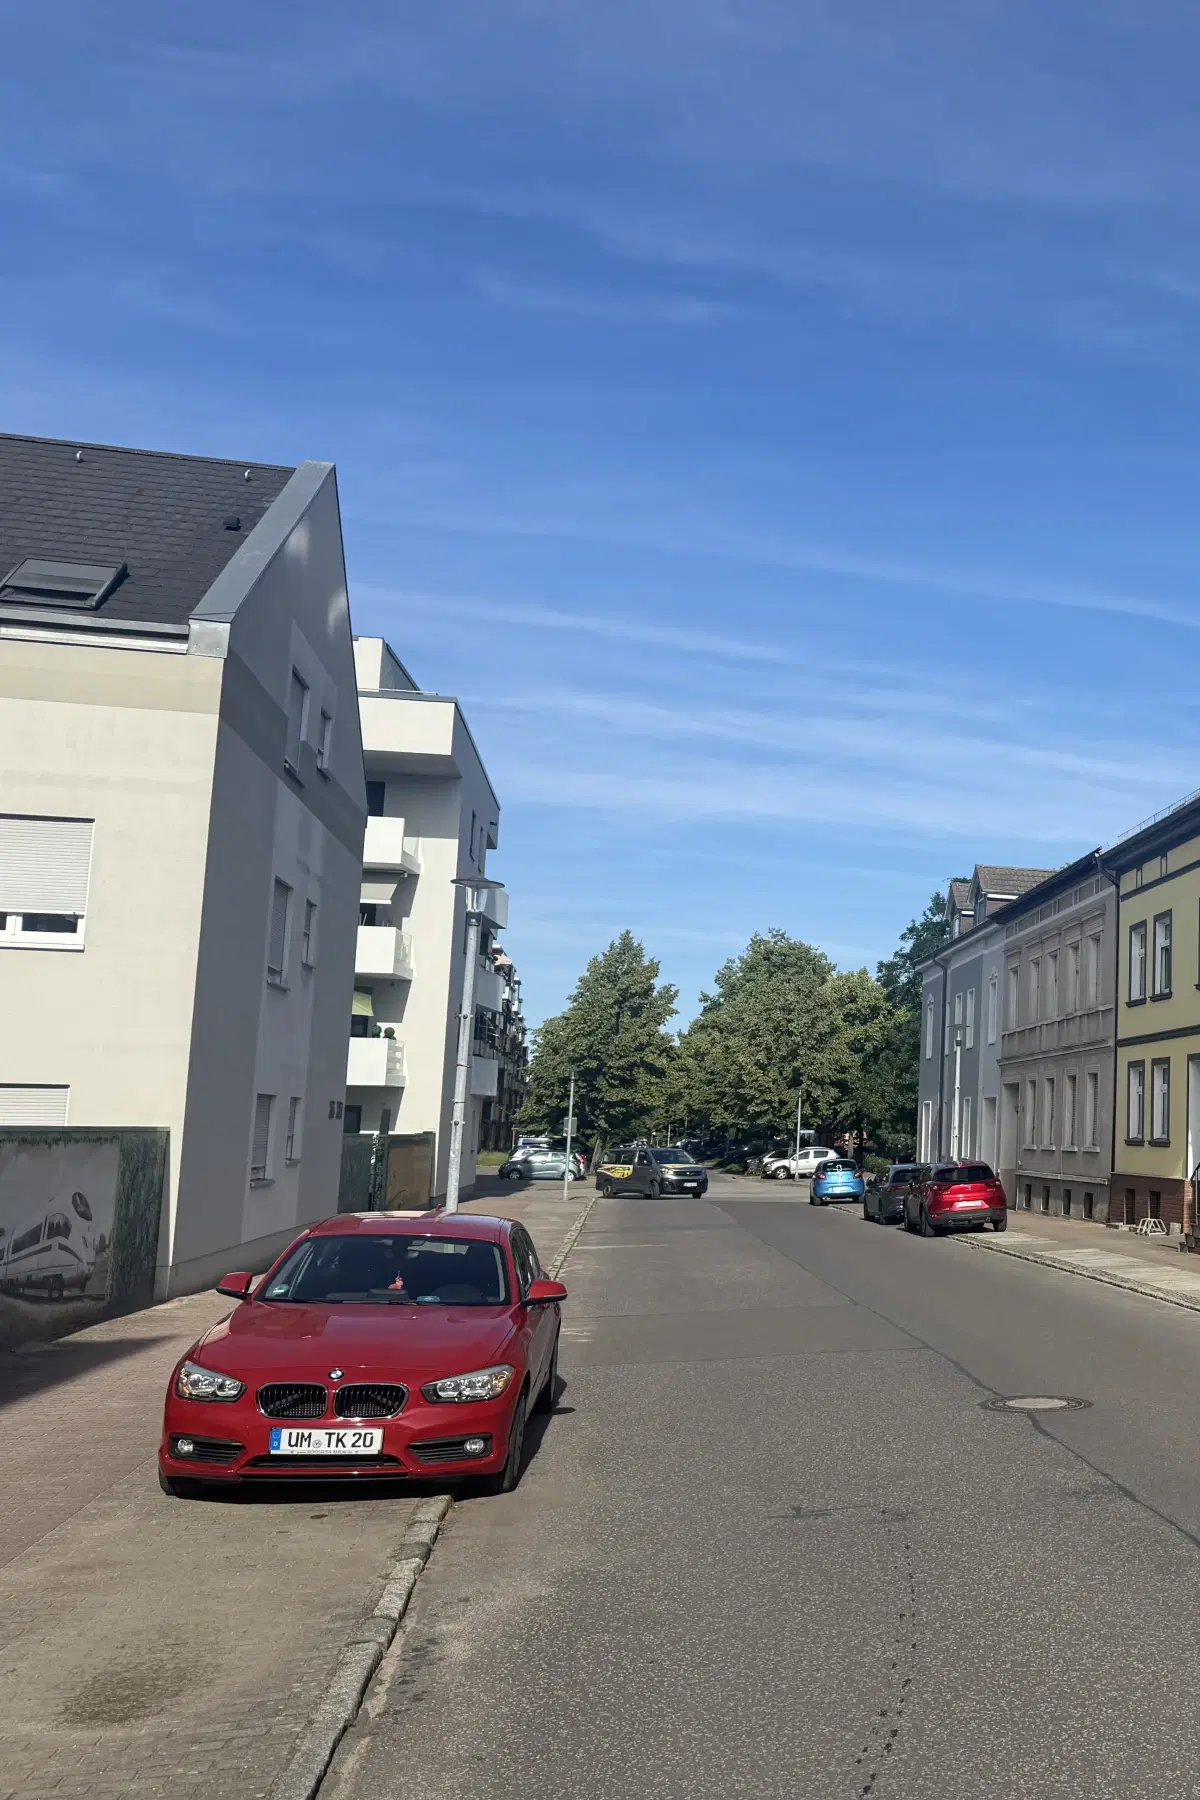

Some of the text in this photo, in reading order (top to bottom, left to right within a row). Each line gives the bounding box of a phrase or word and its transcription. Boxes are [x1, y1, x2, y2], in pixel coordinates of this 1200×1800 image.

[288, 1431, 374, 1448] UM TK 20
